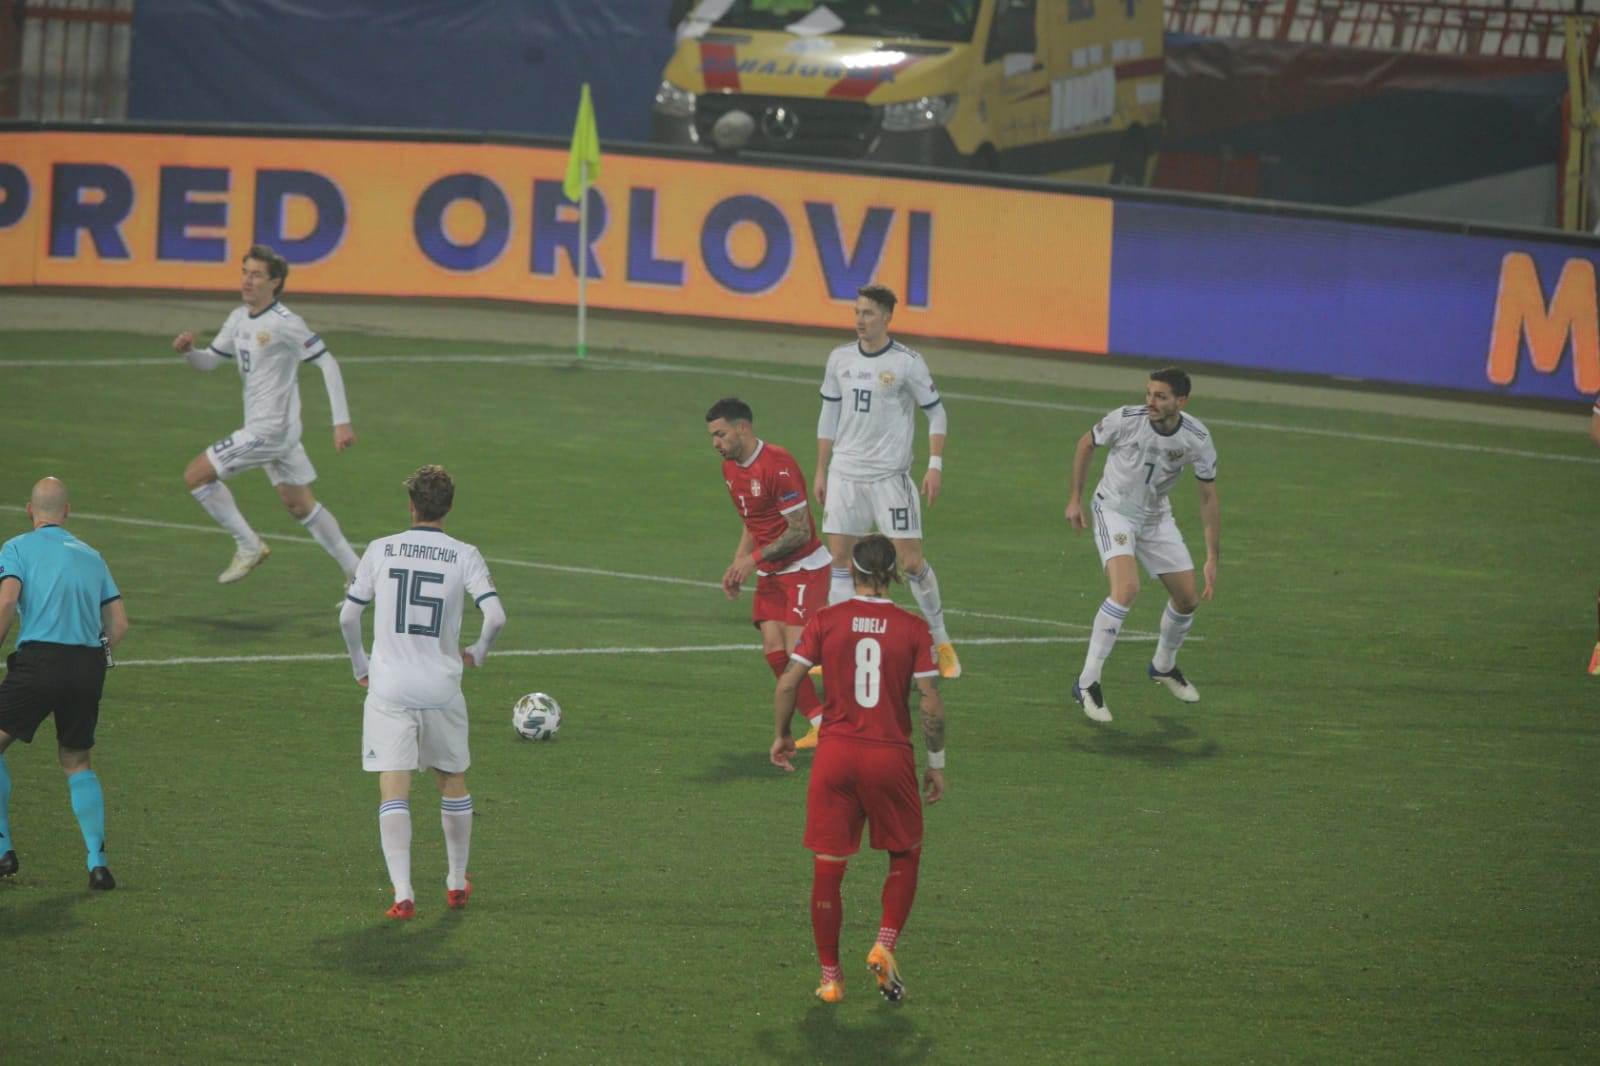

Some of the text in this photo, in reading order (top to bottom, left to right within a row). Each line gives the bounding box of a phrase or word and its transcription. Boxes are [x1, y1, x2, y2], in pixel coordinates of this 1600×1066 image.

[413, 172, 933, 308] ORLOVI
[852, 388, 872, 413] 19
[1144, 462, 1155, 485] 7
[888, 507, 909, 531] 19
[388, 567, 445, 638] 15
[796, 584, 807, 606] 7
[852, 617, 887, 633] GUDELJ
[855, 637, 881, 708] 8
